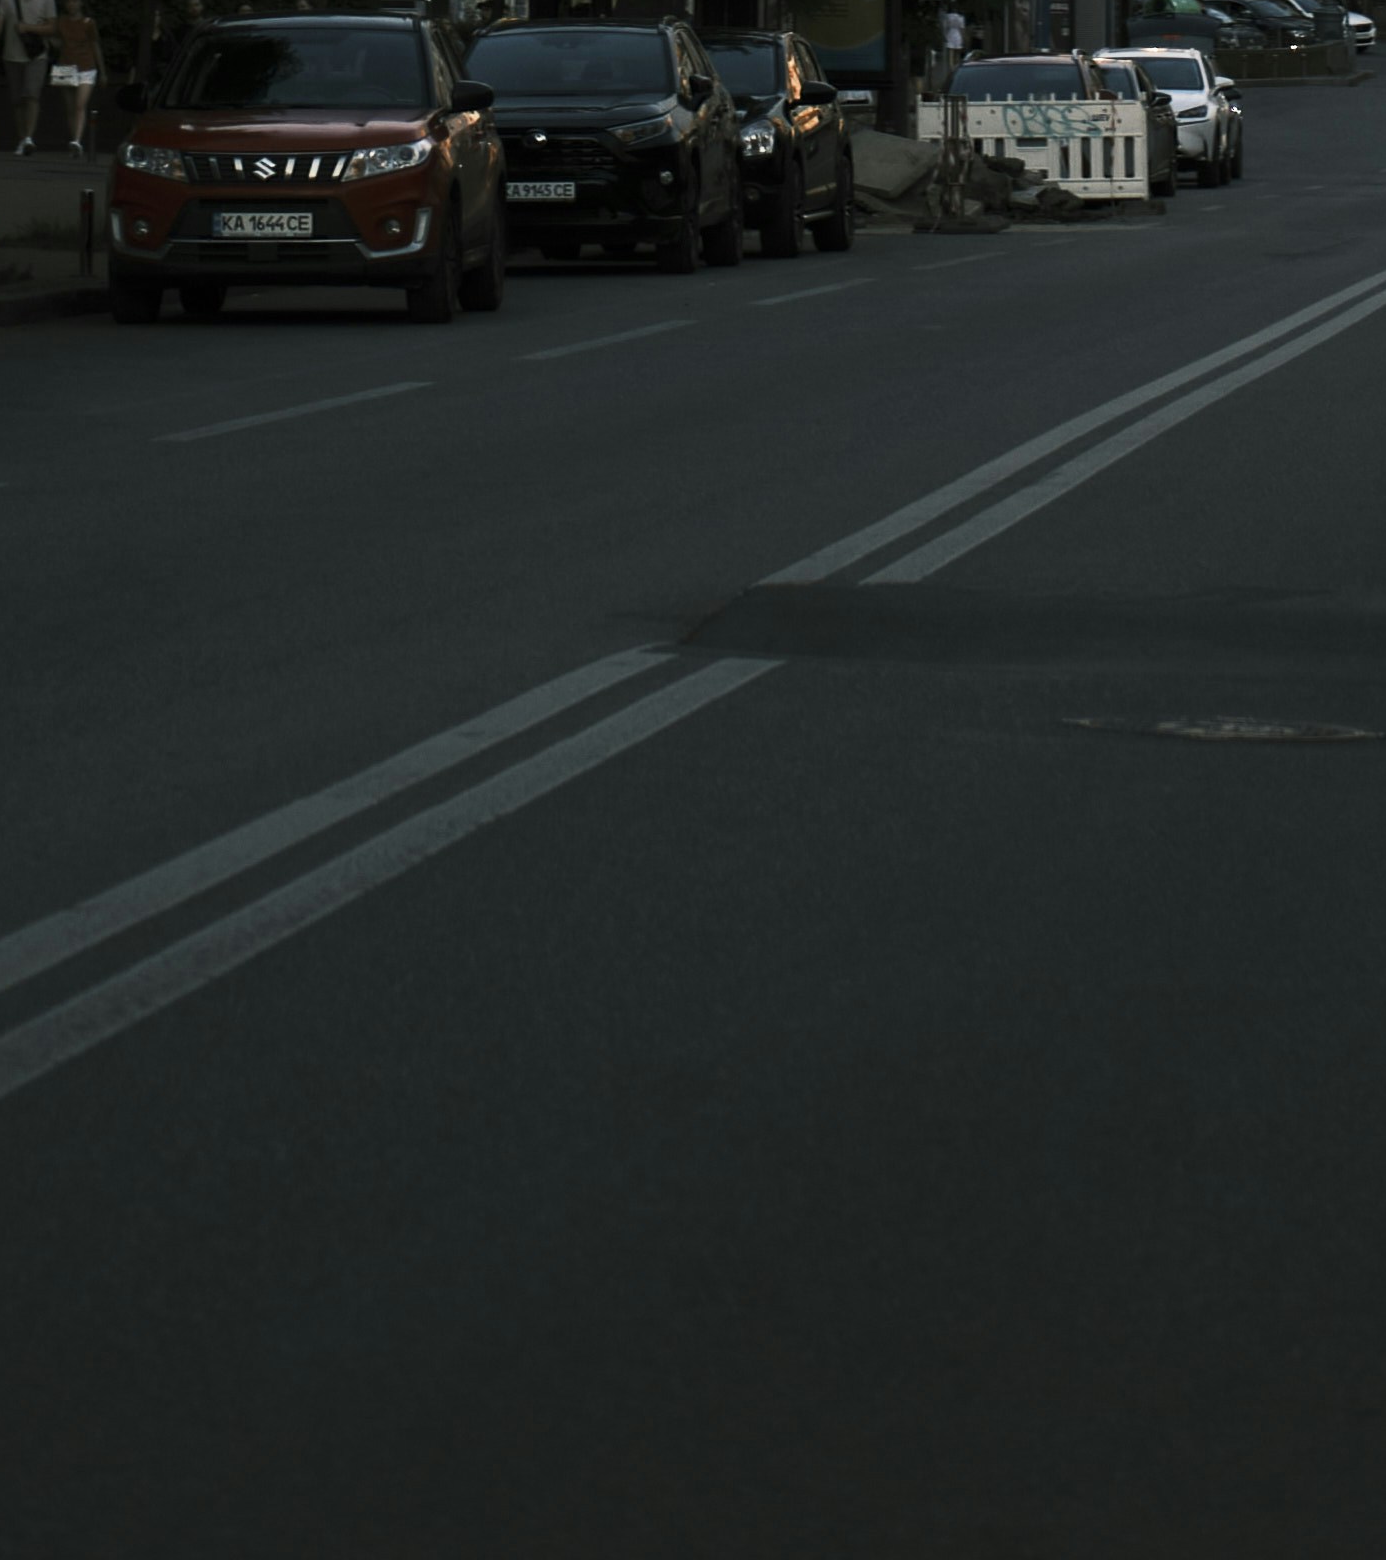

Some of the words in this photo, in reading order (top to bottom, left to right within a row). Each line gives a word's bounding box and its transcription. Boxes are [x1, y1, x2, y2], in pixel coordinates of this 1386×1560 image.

[222, 215, 245, 231] KA
[248, 215, 285, 231] 1644
[286, 215, 310, 231] CE
